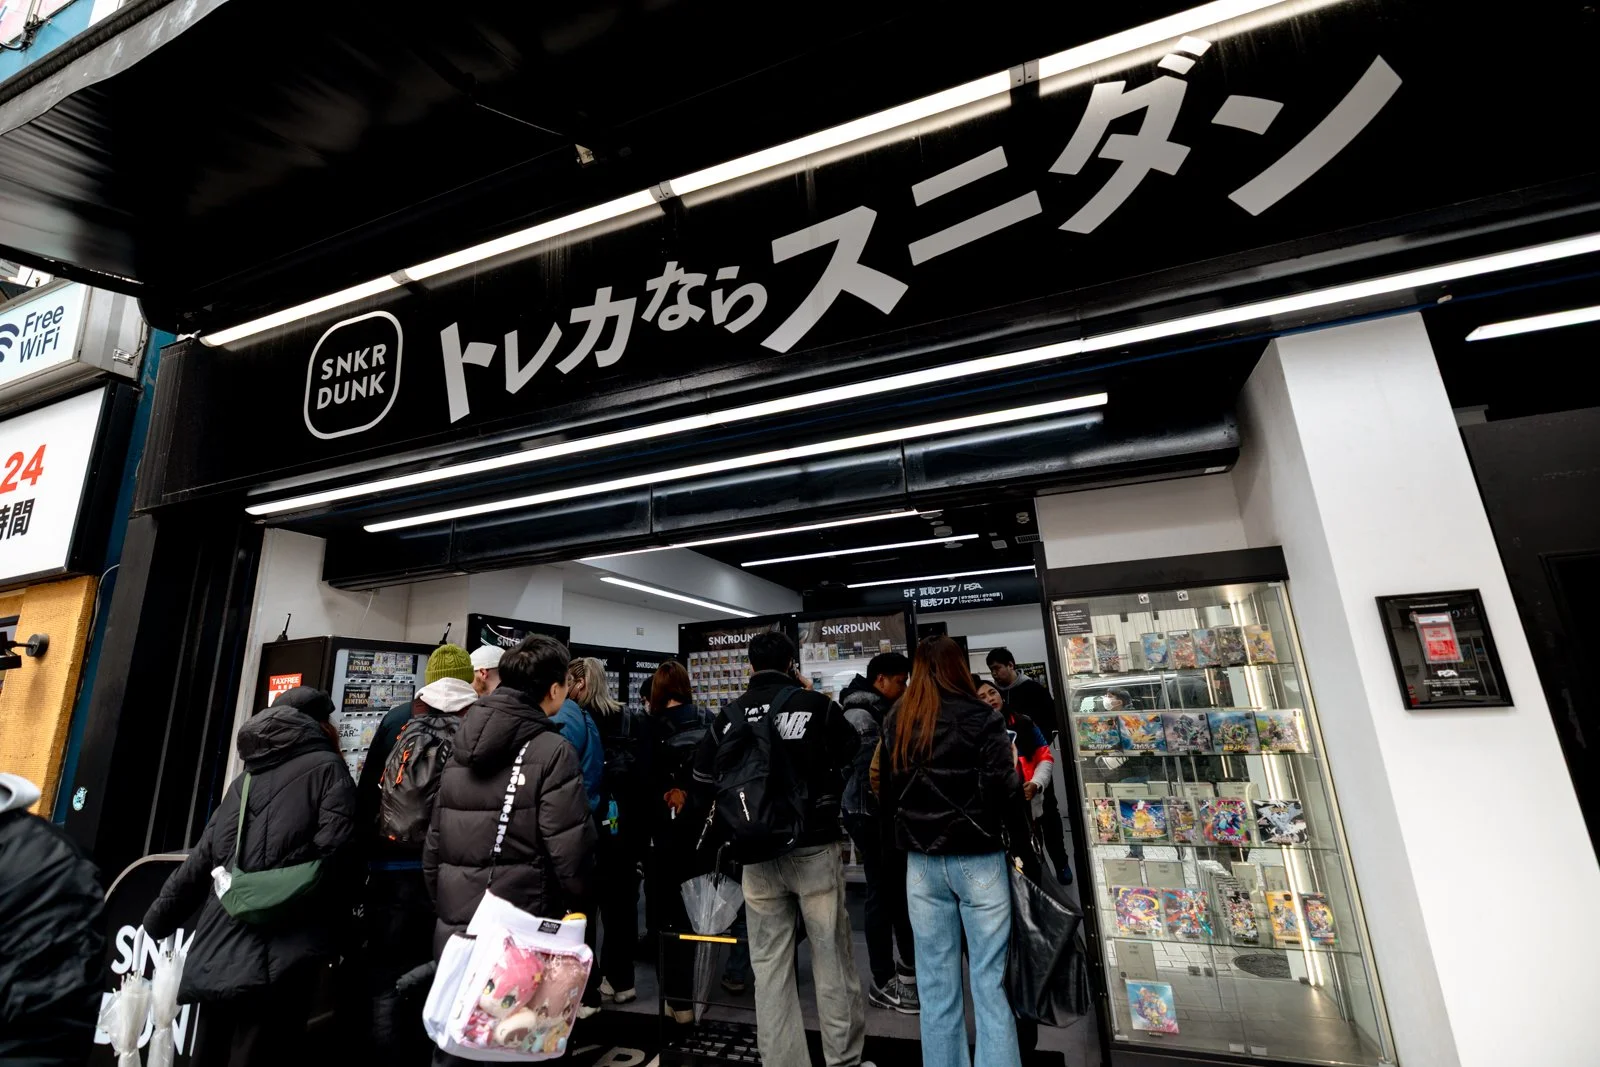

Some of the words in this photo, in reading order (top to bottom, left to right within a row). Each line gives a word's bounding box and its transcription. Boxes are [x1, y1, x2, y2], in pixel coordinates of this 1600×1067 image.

[440, 35, 1403, 424] トレカならスニダン
[23, 306, 64, 337] Free
[20, 326, 60, 363] WiFi
[321, 344, 387, 380] SNKR
[317, 371, 386, 410] DUNK
[0, 444, 46, 494] 24
[904, 588, 916, 598] 5F
[708, 632, 761, 646] SNKRDUN
[821, 620, 881, 636] SNKRDUNK
